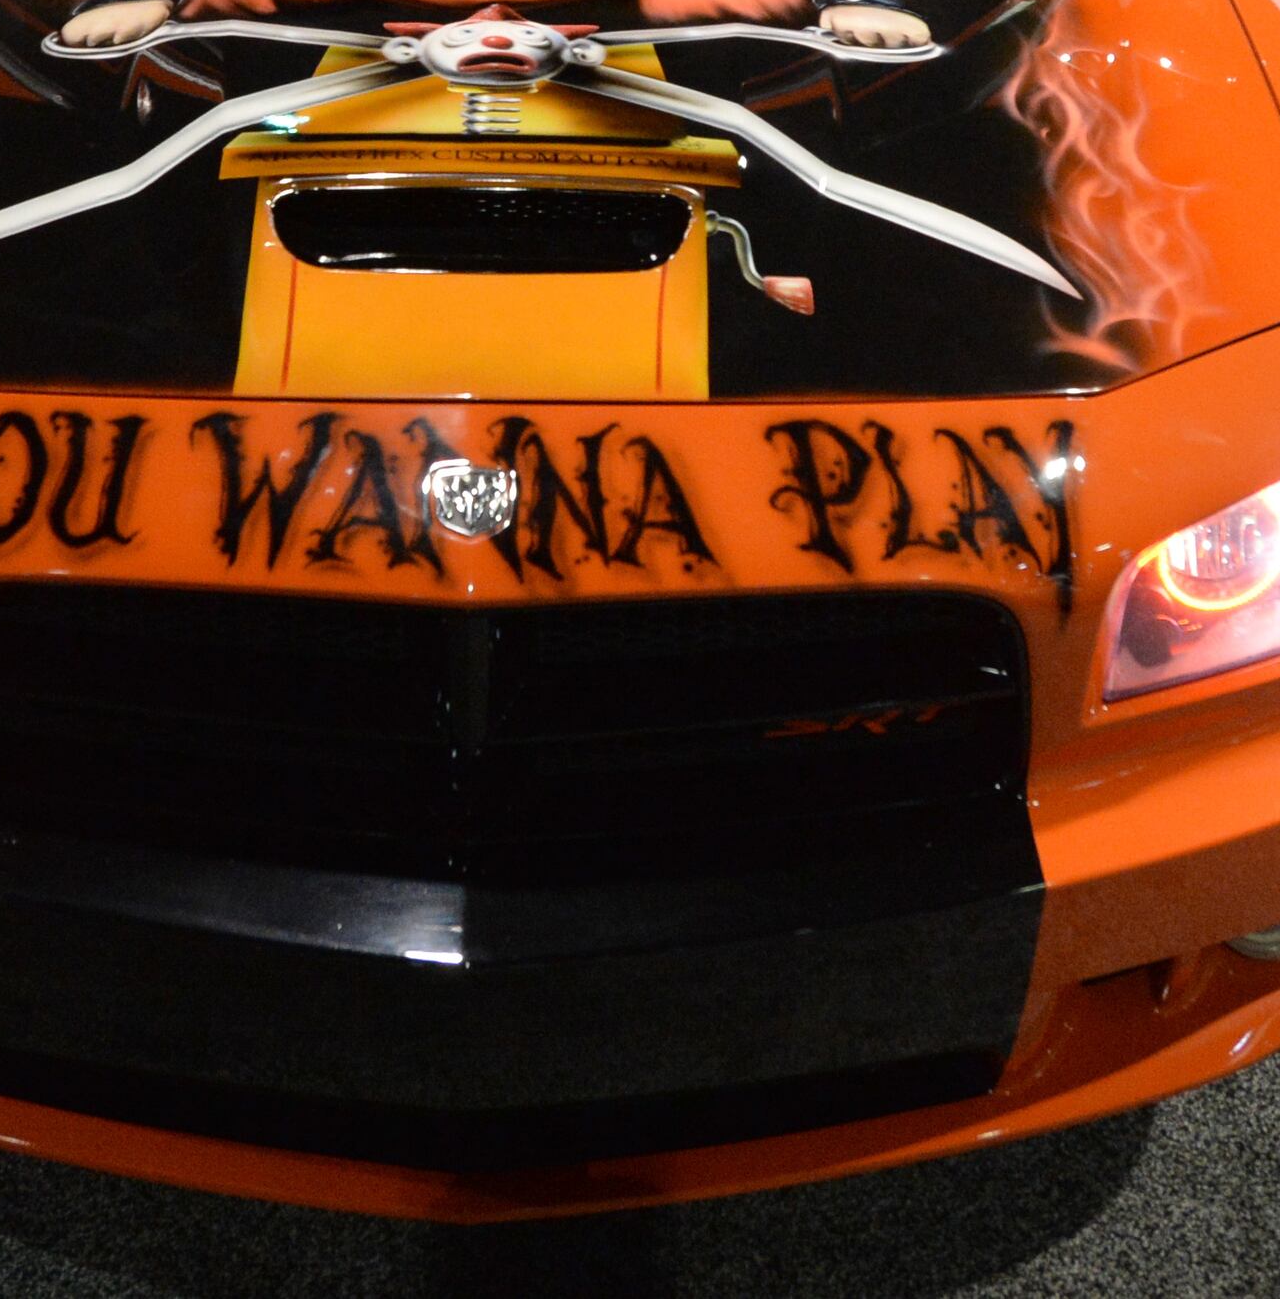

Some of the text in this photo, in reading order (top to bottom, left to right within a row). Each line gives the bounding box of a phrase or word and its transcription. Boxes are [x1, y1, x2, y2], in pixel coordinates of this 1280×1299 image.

[431, 149, 559, 164] CUSTOM
[190, 409, 720, 585] WANNA
[763, 418, 1077, 629] PLAY
